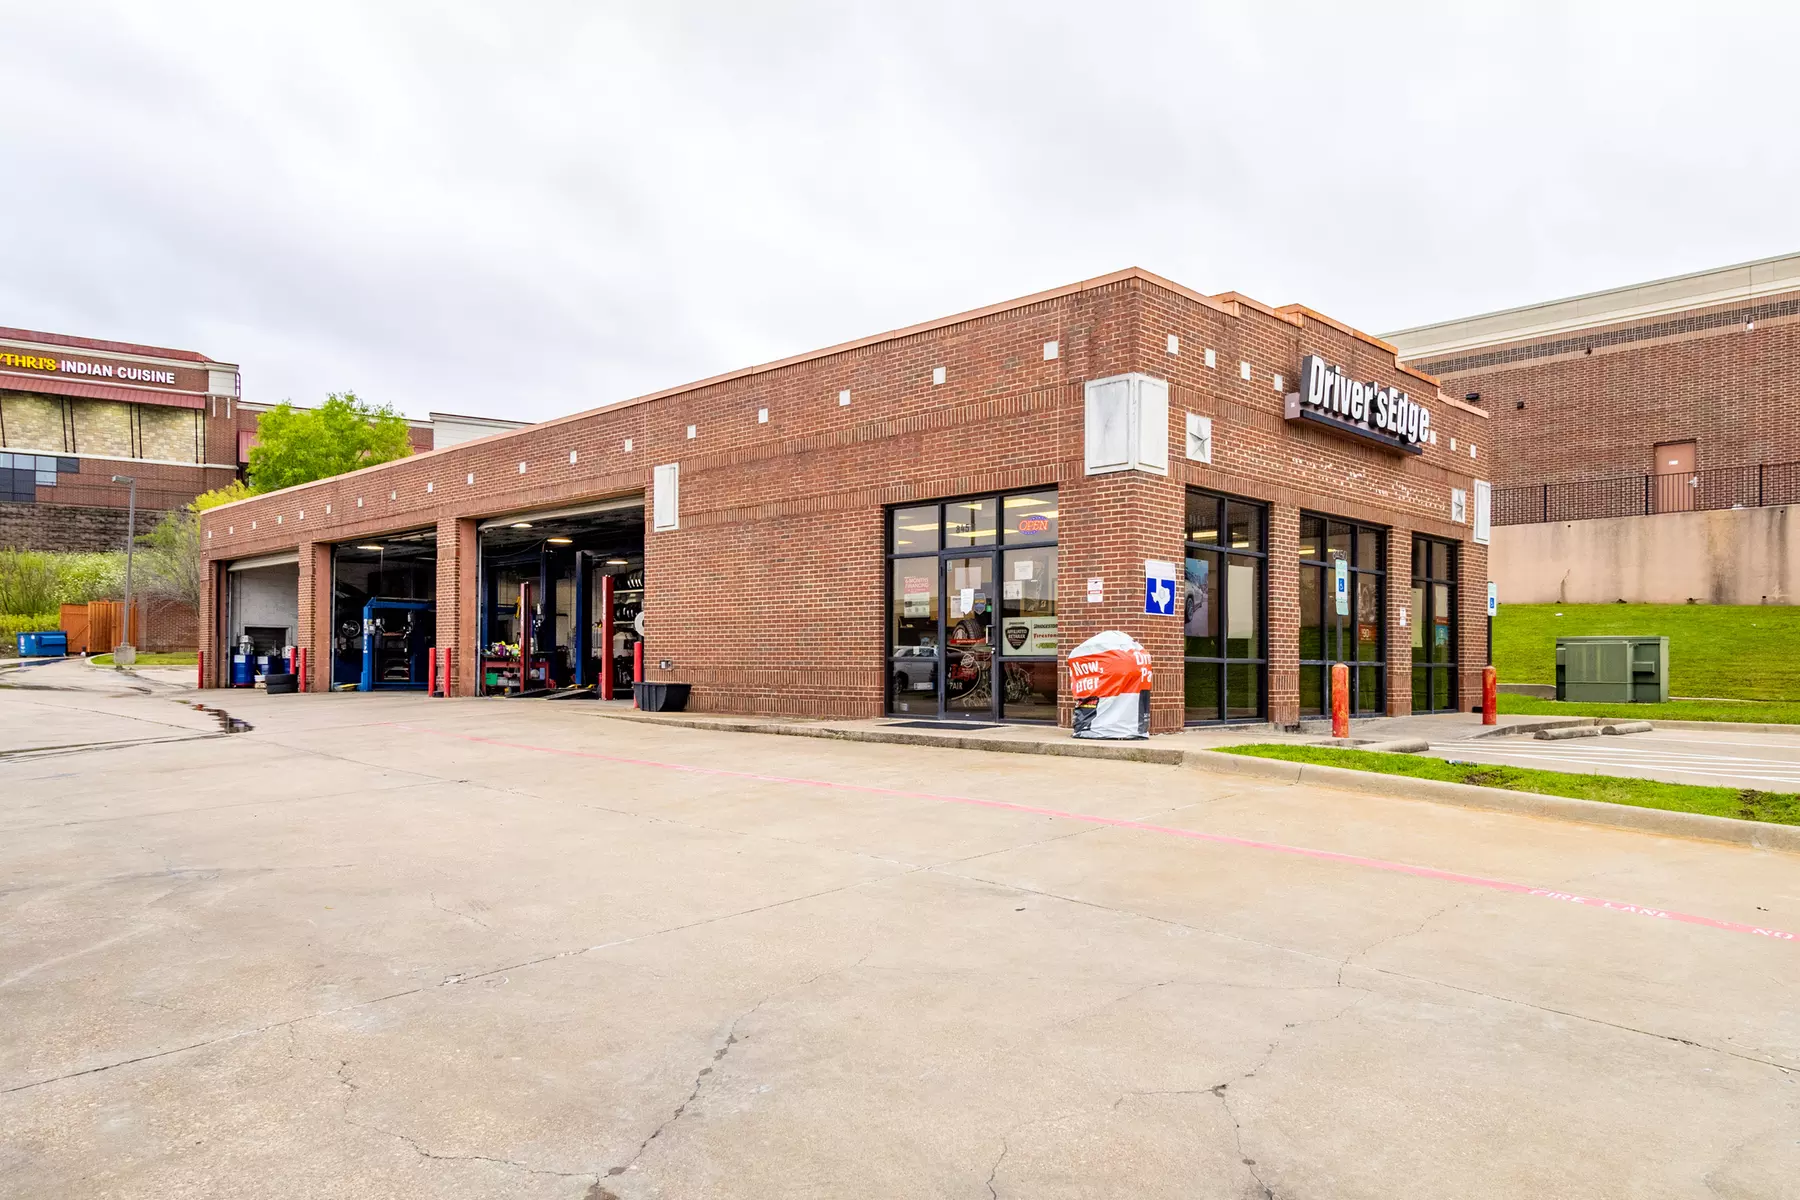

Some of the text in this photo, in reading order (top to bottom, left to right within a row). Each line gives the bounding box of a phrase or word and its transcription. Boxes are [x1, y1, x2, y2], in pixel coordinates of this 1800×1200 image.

[61, 359, 113, 377] INDIAN
[117, 366, 175, 384] CUISINE
[1018, 519, 1049, 531] OPEN
[1072, 660, 1104, 677] Now,
